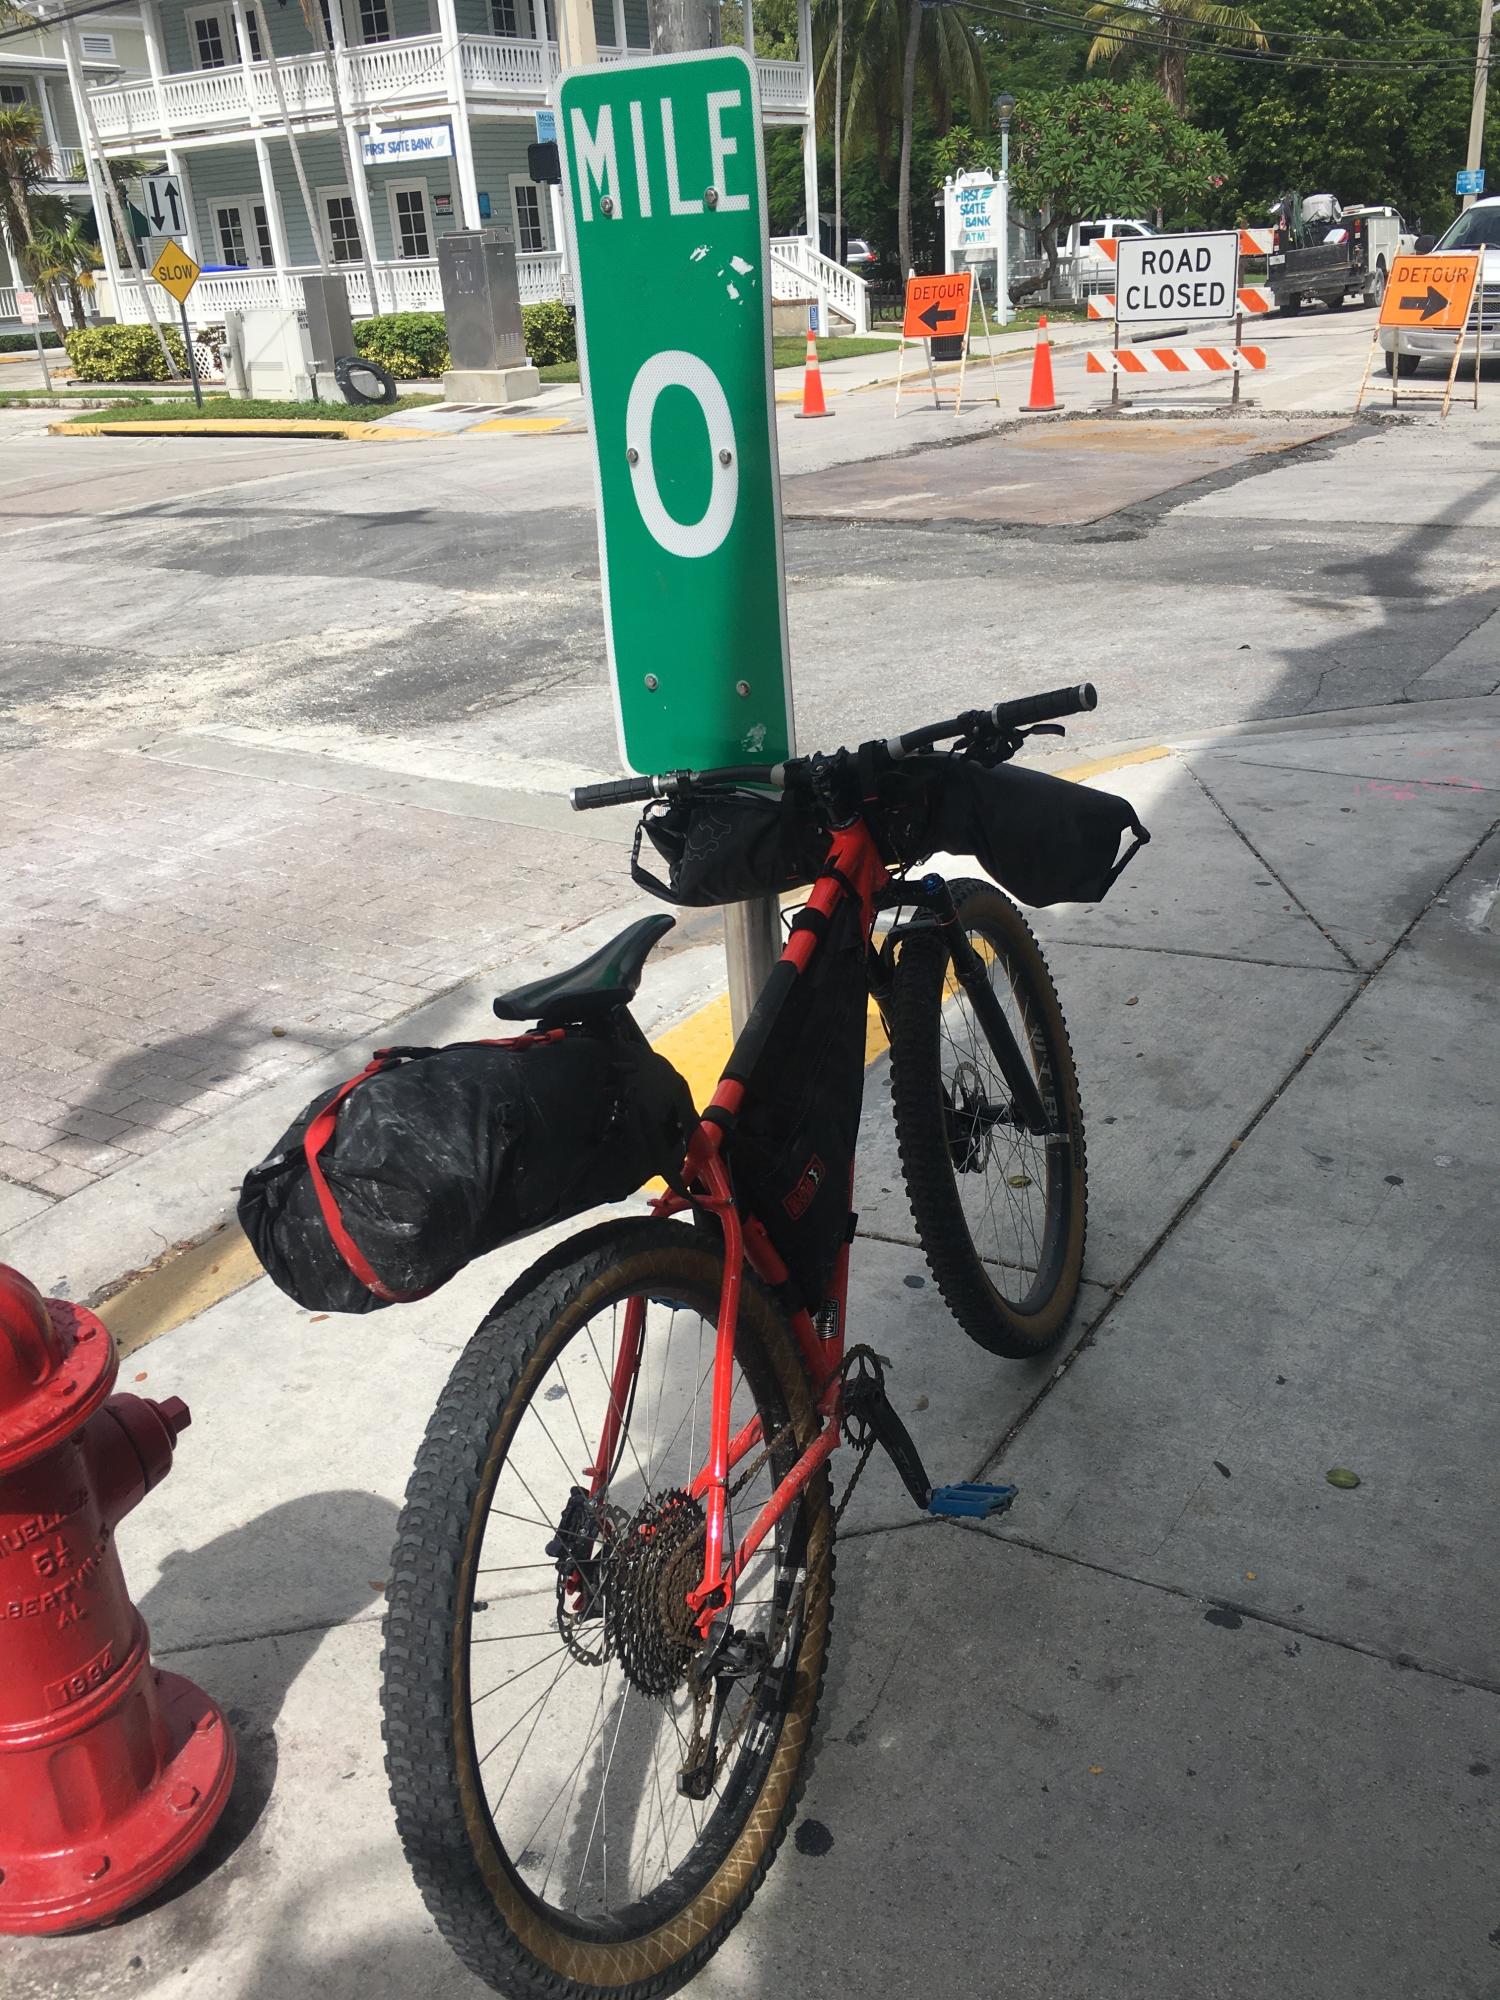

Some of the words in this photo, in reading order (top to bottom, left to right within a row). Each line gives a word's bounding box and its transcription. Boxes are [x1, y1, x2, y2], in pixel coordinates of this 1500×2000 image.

[364, 142, 386, 157] FIRST
[388, 139, 410, 154] STATE
[410, 137, 434, 152] BANK
[570, 89, 750, 222] MILE
[955, 188, 980, 203] FIRST
[959, 202, 986, 216] STATE
[965, 215, 991, 228] BANK
[964, 231, 986, 242] ATM
[1141, 247, 1211, 275] ROAD
[158, 264, 192, 281] SLOW
[1398, 267, 1469, 283] DETOUR
[913, 282, 965, 300] DETOUR
[1126, 282, 1225, 310] CLOSED
[626, 350, 739, 558] 0
